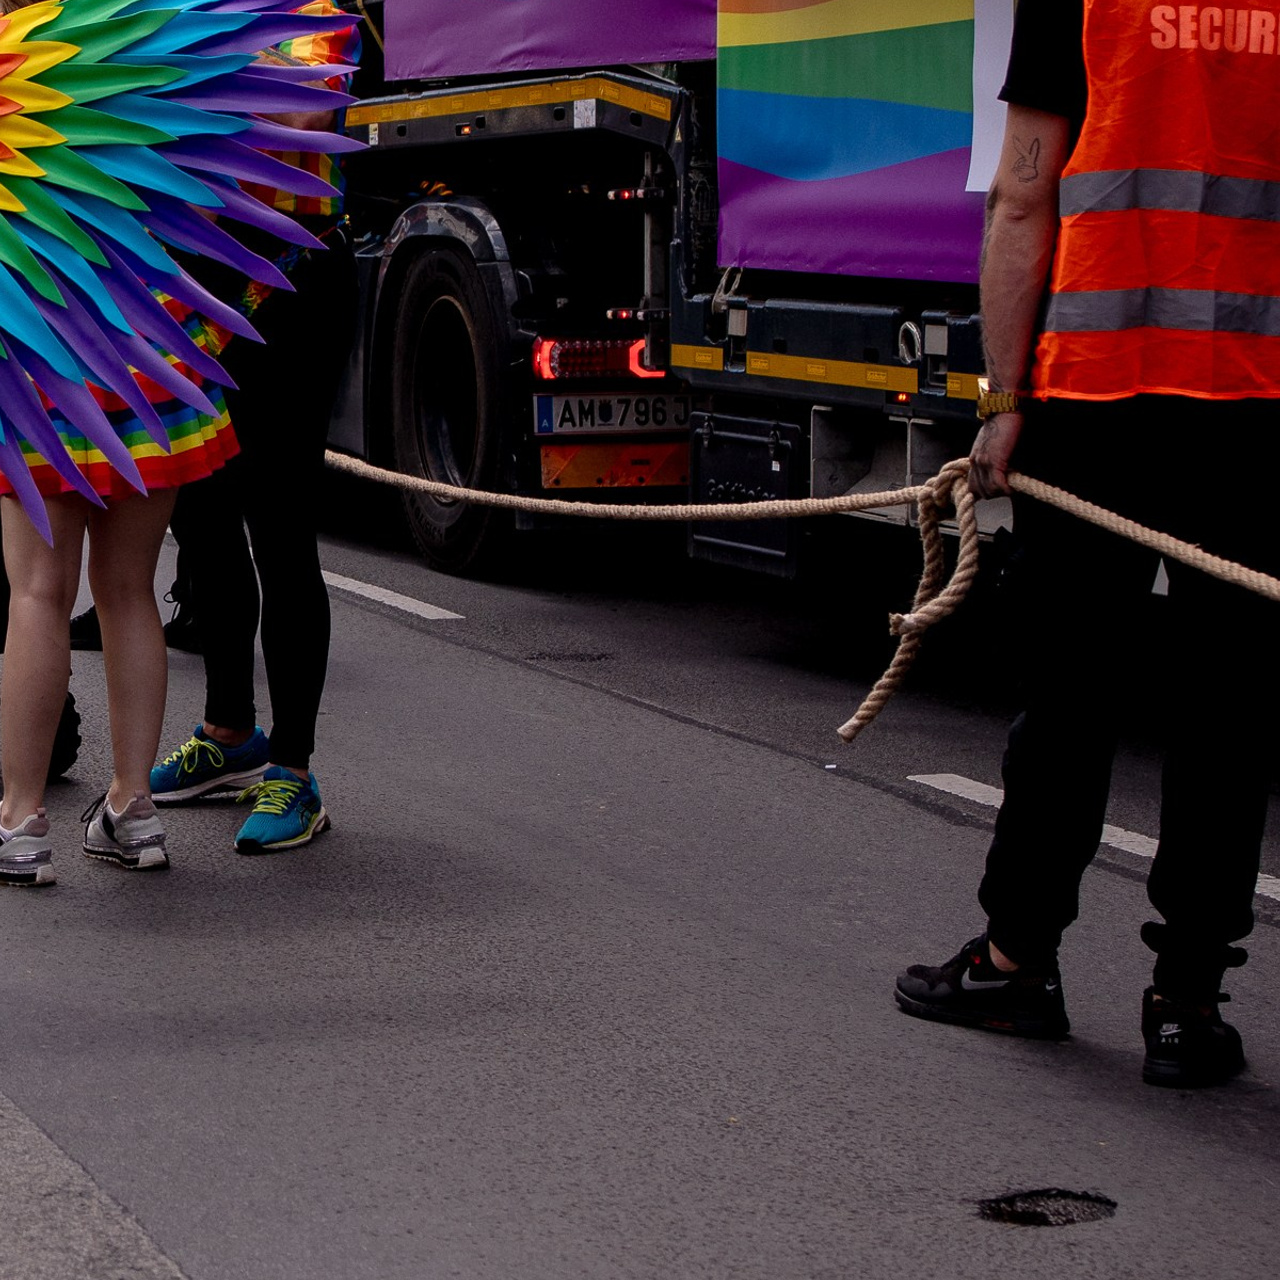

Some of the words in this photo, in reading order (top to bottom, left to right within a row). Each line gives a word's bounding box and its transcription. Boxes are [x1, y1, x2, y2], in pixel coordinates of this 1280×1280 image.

[1150, 5, 1280, 55] SECUR
[541, 418, 549, 428] A
[558, 399, 596, 428] AM
[616, 396, 668, 426] 796
